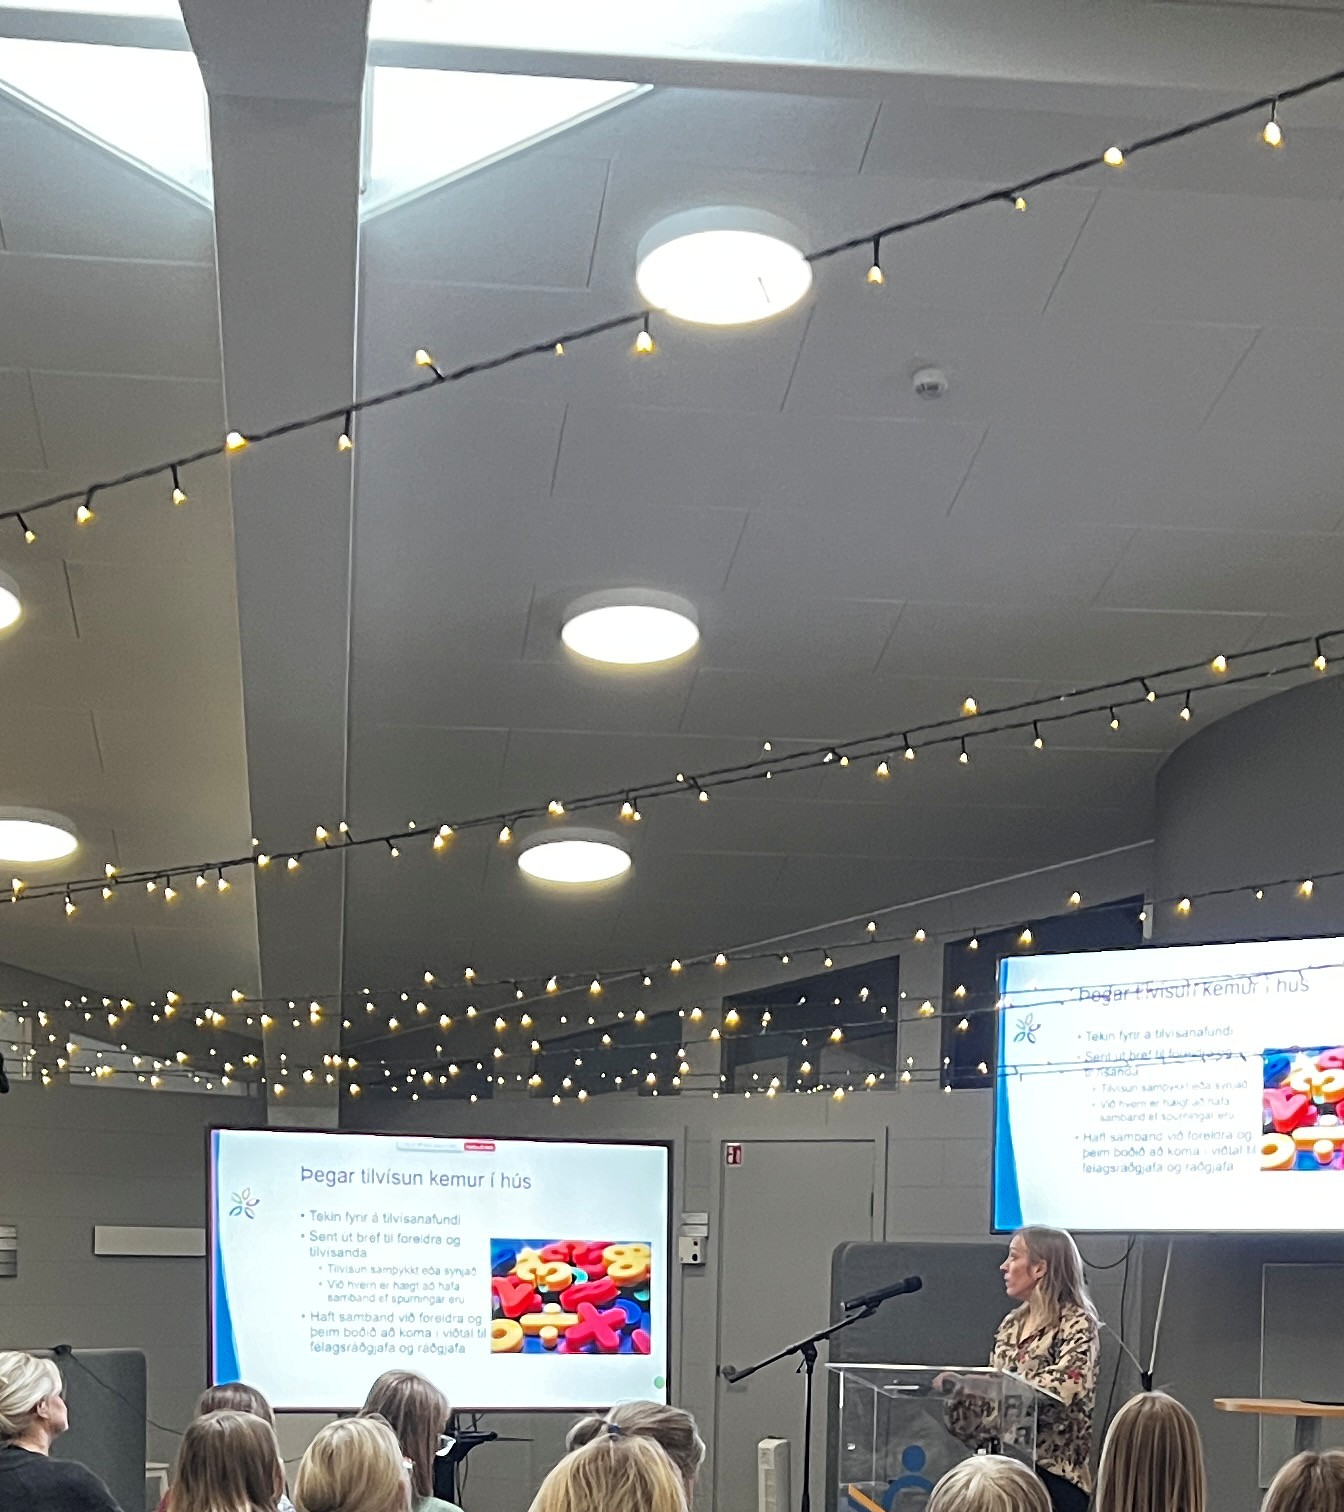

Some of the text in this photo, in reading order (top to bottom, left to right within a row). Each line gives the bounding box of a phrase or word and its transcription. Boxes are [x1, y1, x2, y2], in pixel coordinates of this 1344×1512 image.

[300, 1165, 355, 1188] Þegar
[360, 1167, 424, 1186] tilvísun
[429, 1169, 485, 1188] kemur
[500, 1171, 532, 1190] hús
[309, 1209, 342, 1223] Tekin
[309, 1229, 338, 1243] Sent
[445, 1235, 461, 1248] og
[310, 1310, 482, 1327] Haft samband við foreldra og
[310, 1326, 340, 1340] þeim
[343, 1326, 378, 1338] boðið
[380, 1327, 396, 1338] að
[399, 1327, 432, 1339] koma
[443, 1328, 474, 1340] viðtal
[398, 1344, 414, 1356] og
